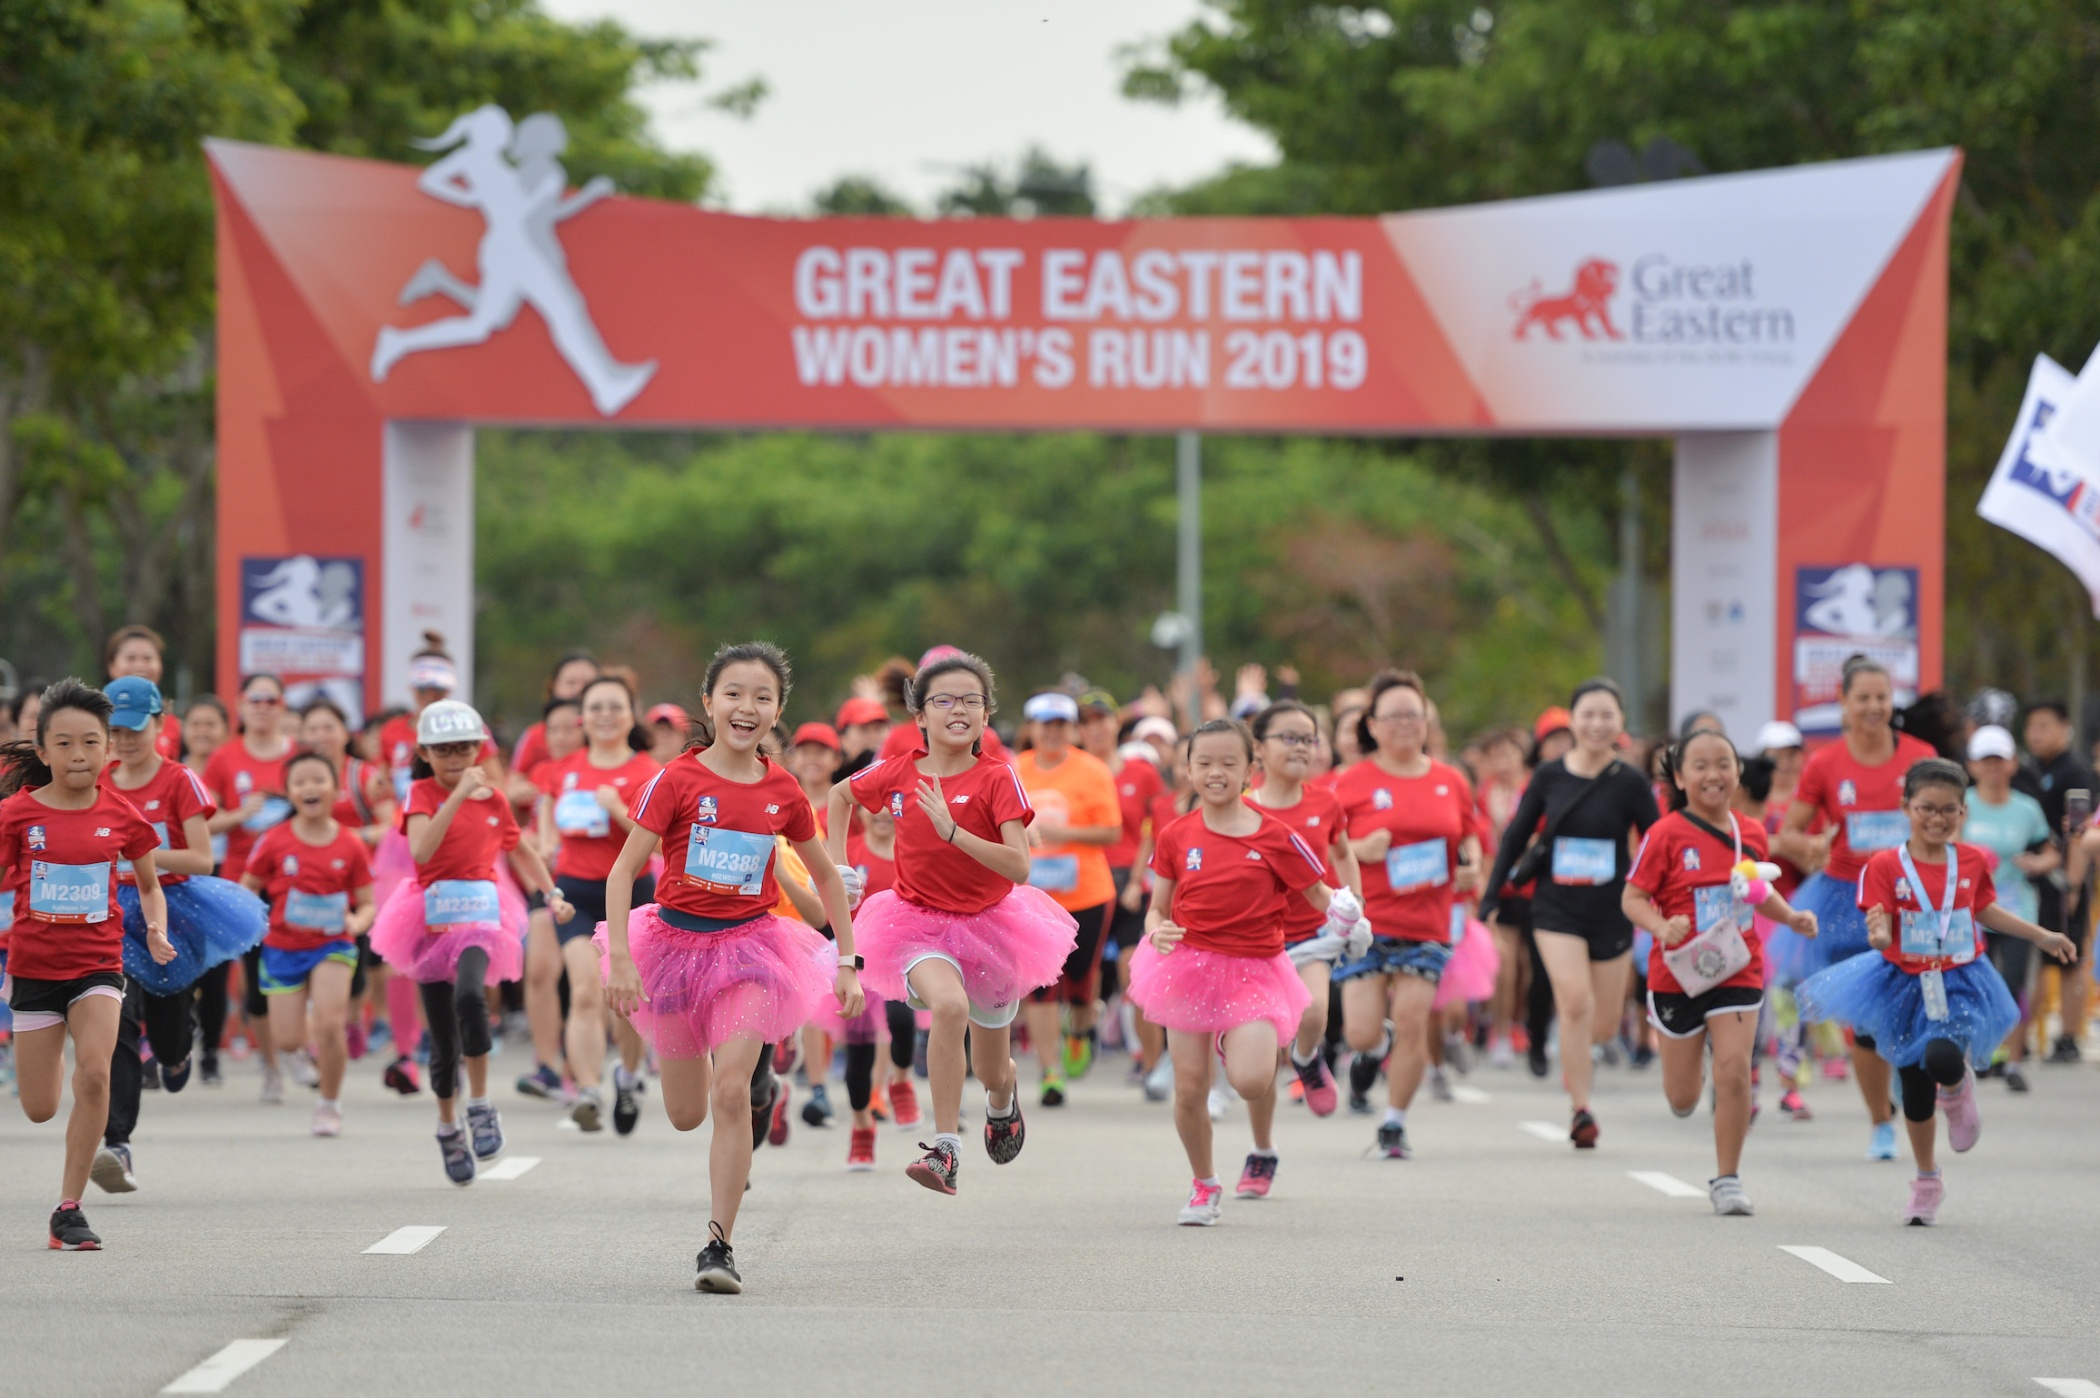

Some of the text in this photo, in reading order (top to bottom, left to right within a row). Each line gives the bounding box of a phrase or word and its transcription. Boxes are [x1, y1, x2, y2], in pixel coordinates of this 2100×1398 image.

[795, 247, 1362, 320] GREAT EASTERN
[1631, 254, 1754, 301] Great
[1631, 302, 1795, 343] Eastern
[792, 326, 1368, 390] WOMEN'S RUN 2019
[764, 803, 780, 814] NB
[94, 827, 110, 836] NB
[699, 848, 760, 873] M2388
[41, 883, 100, 902] M2309
